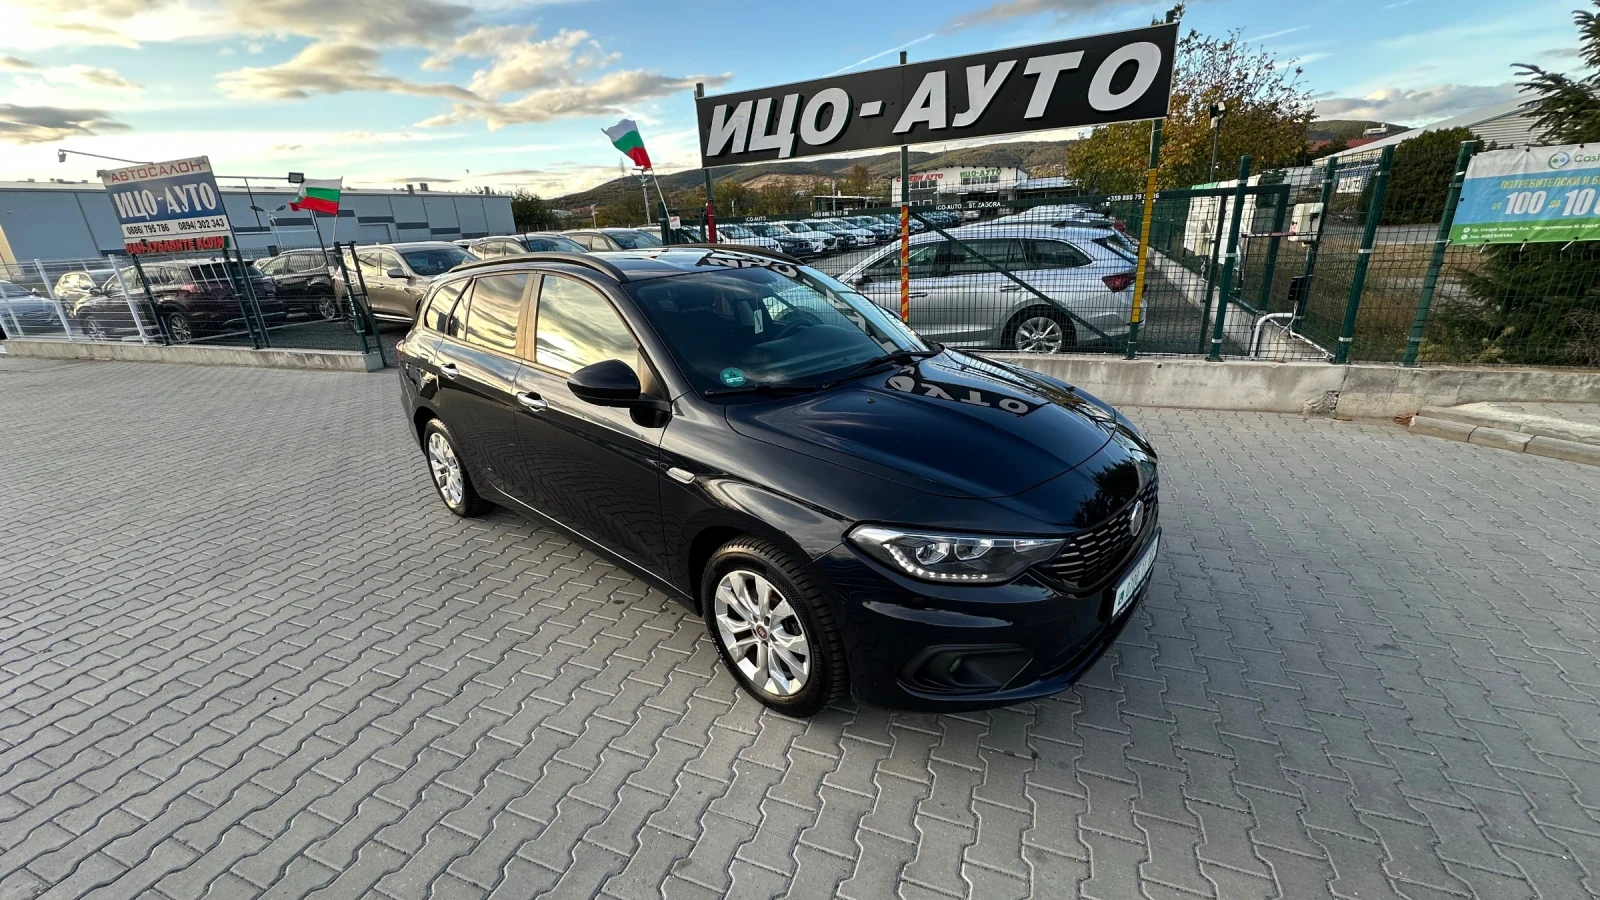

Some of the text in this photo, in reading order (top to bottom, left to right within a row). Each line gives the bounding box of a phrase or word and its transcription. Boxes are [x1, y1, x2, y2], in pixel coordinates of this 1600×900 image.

[111, 161, 202, 183] АВТОСАЛОН
[1501, 177, 1580, 189] ПОТРЕБИТЕЛСКИ
[1505, 190, 1547, 215] 100
[144, 224, 157, 233] 795
[157, 223, 170, 232] 786
[197, 219, 211, 229] 302
[211, 218, 225, 228] 343
[196, 236, 224, 250] КОЛИ
